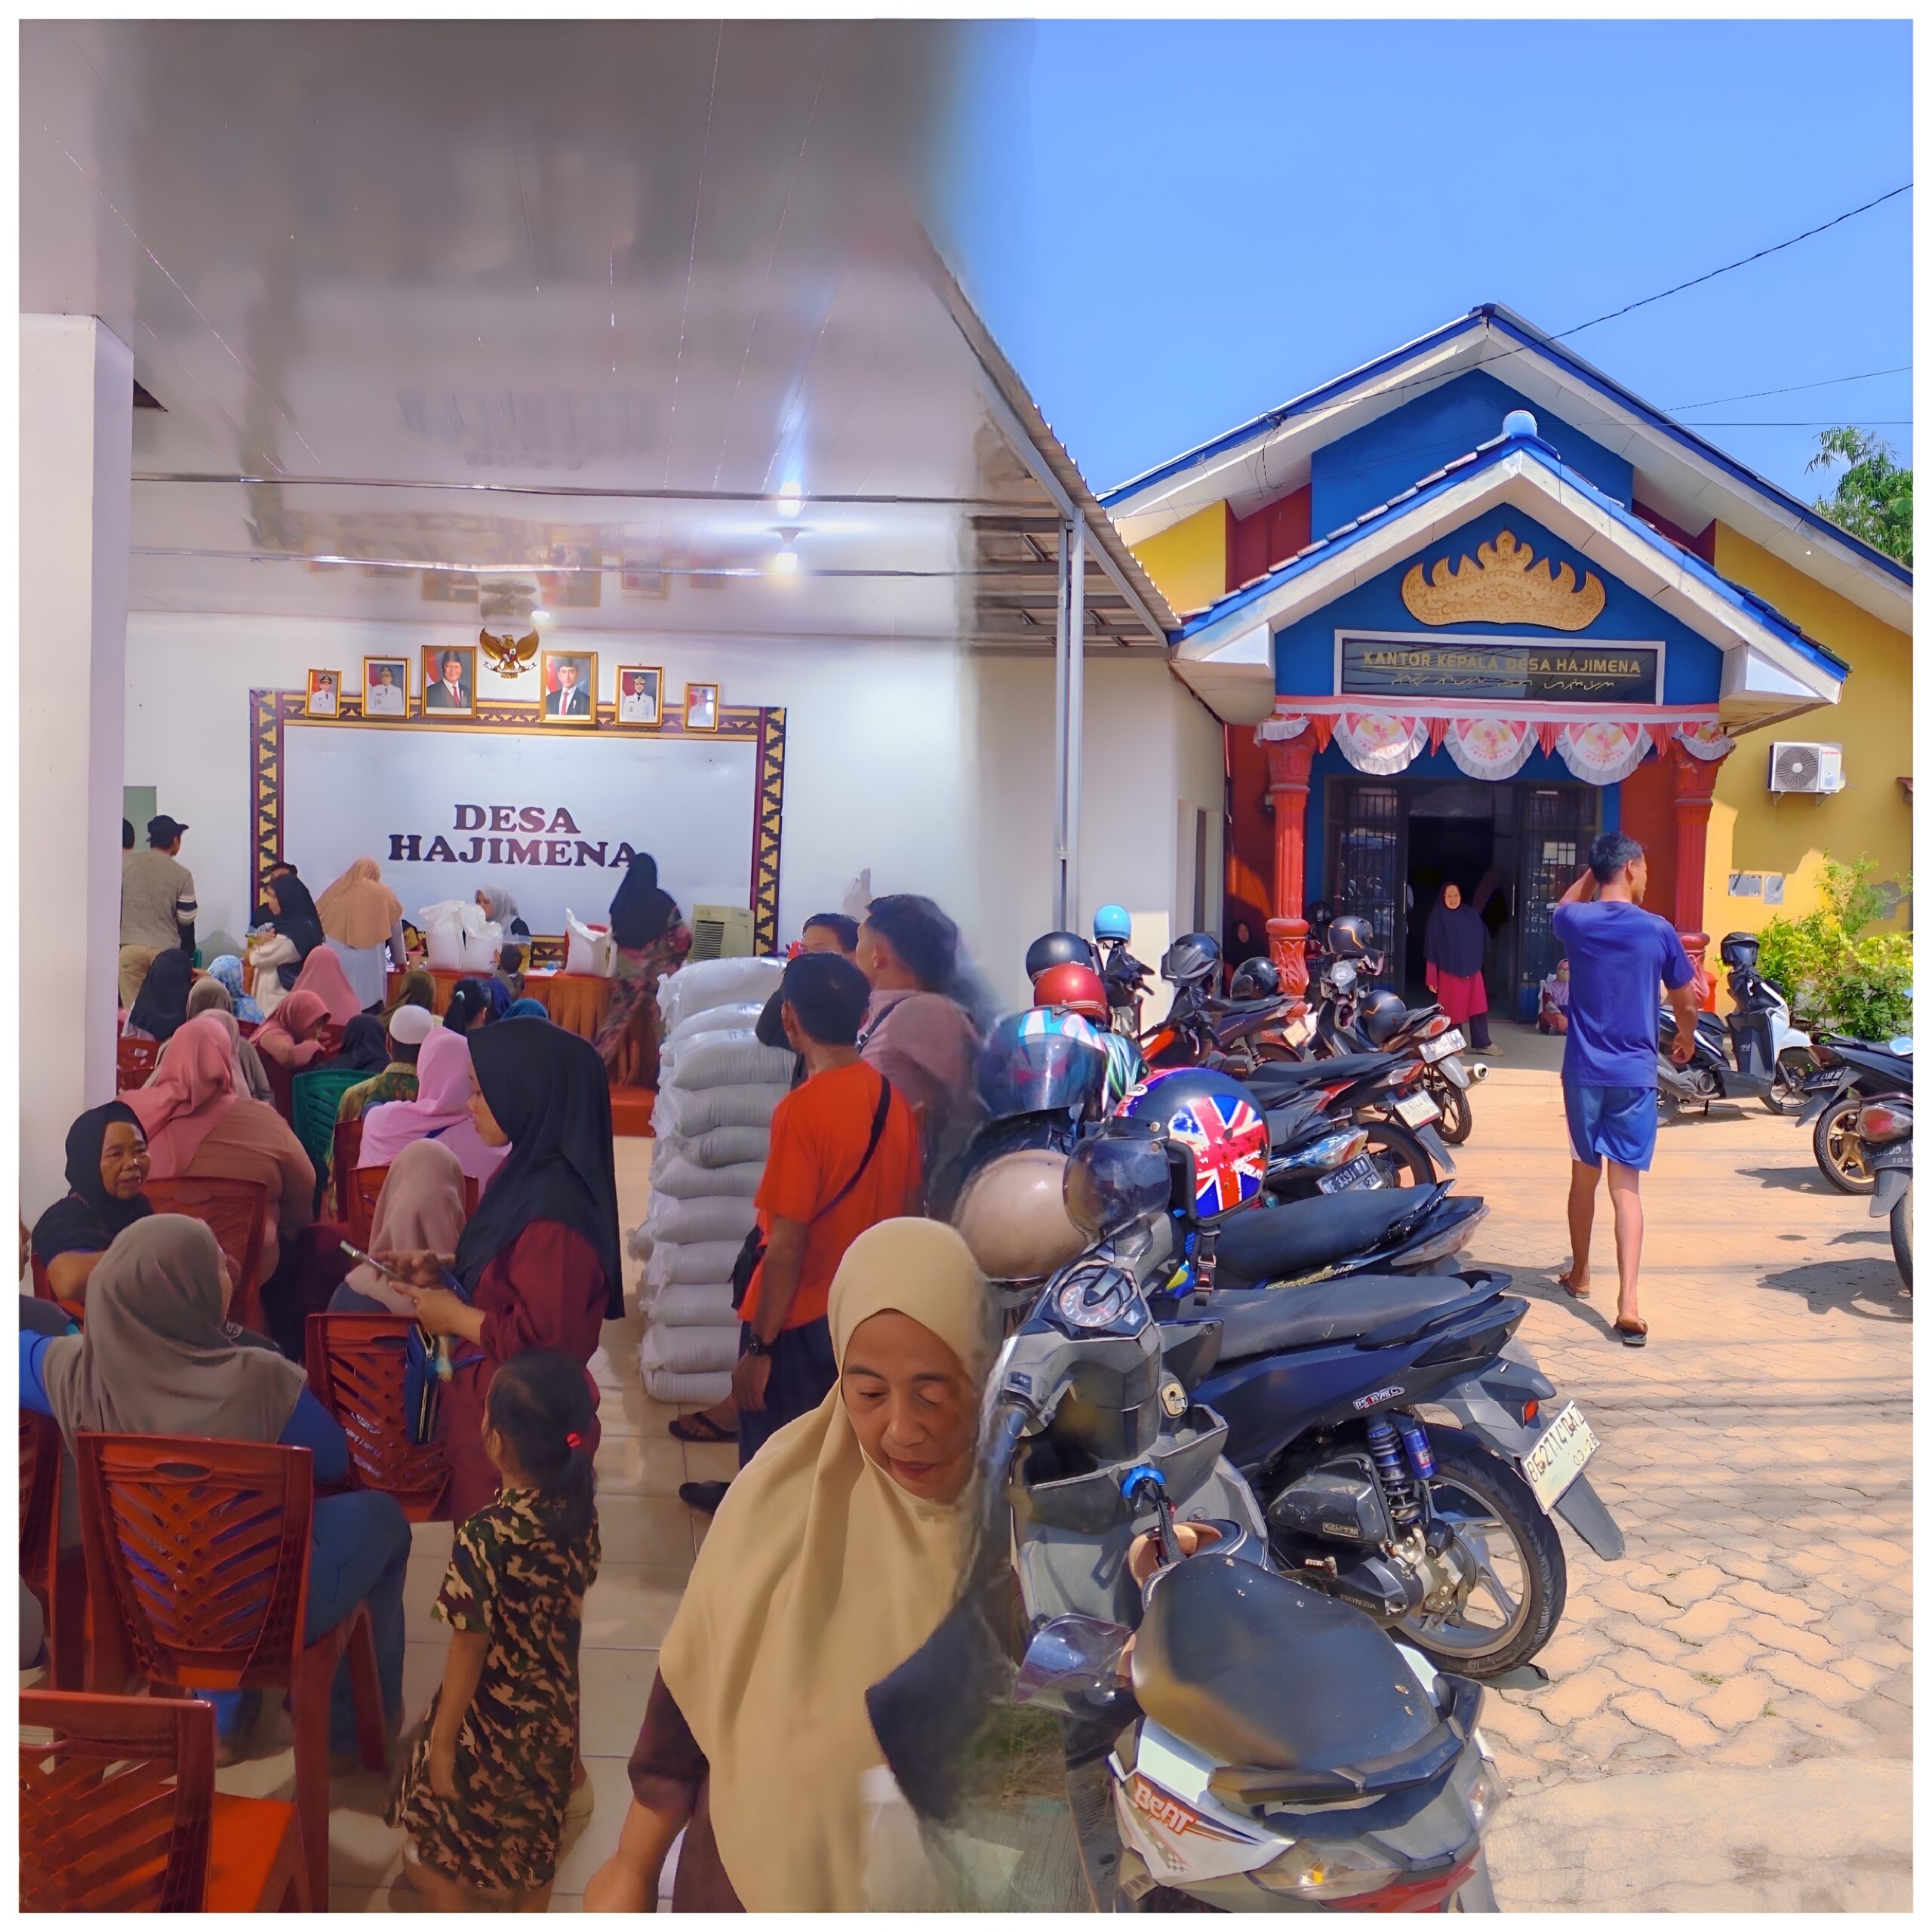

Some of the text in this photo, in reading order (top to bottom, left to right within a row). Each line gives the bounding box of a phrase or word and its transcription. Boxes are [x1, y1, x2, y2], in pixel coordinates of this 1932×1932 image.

[1364, 651, 1641, 674] KANTOR KEPALA DESA HAJIMENA
[453, 804, 581, 834] DESA
[388, 834, 636, 868] HAJIMENA
